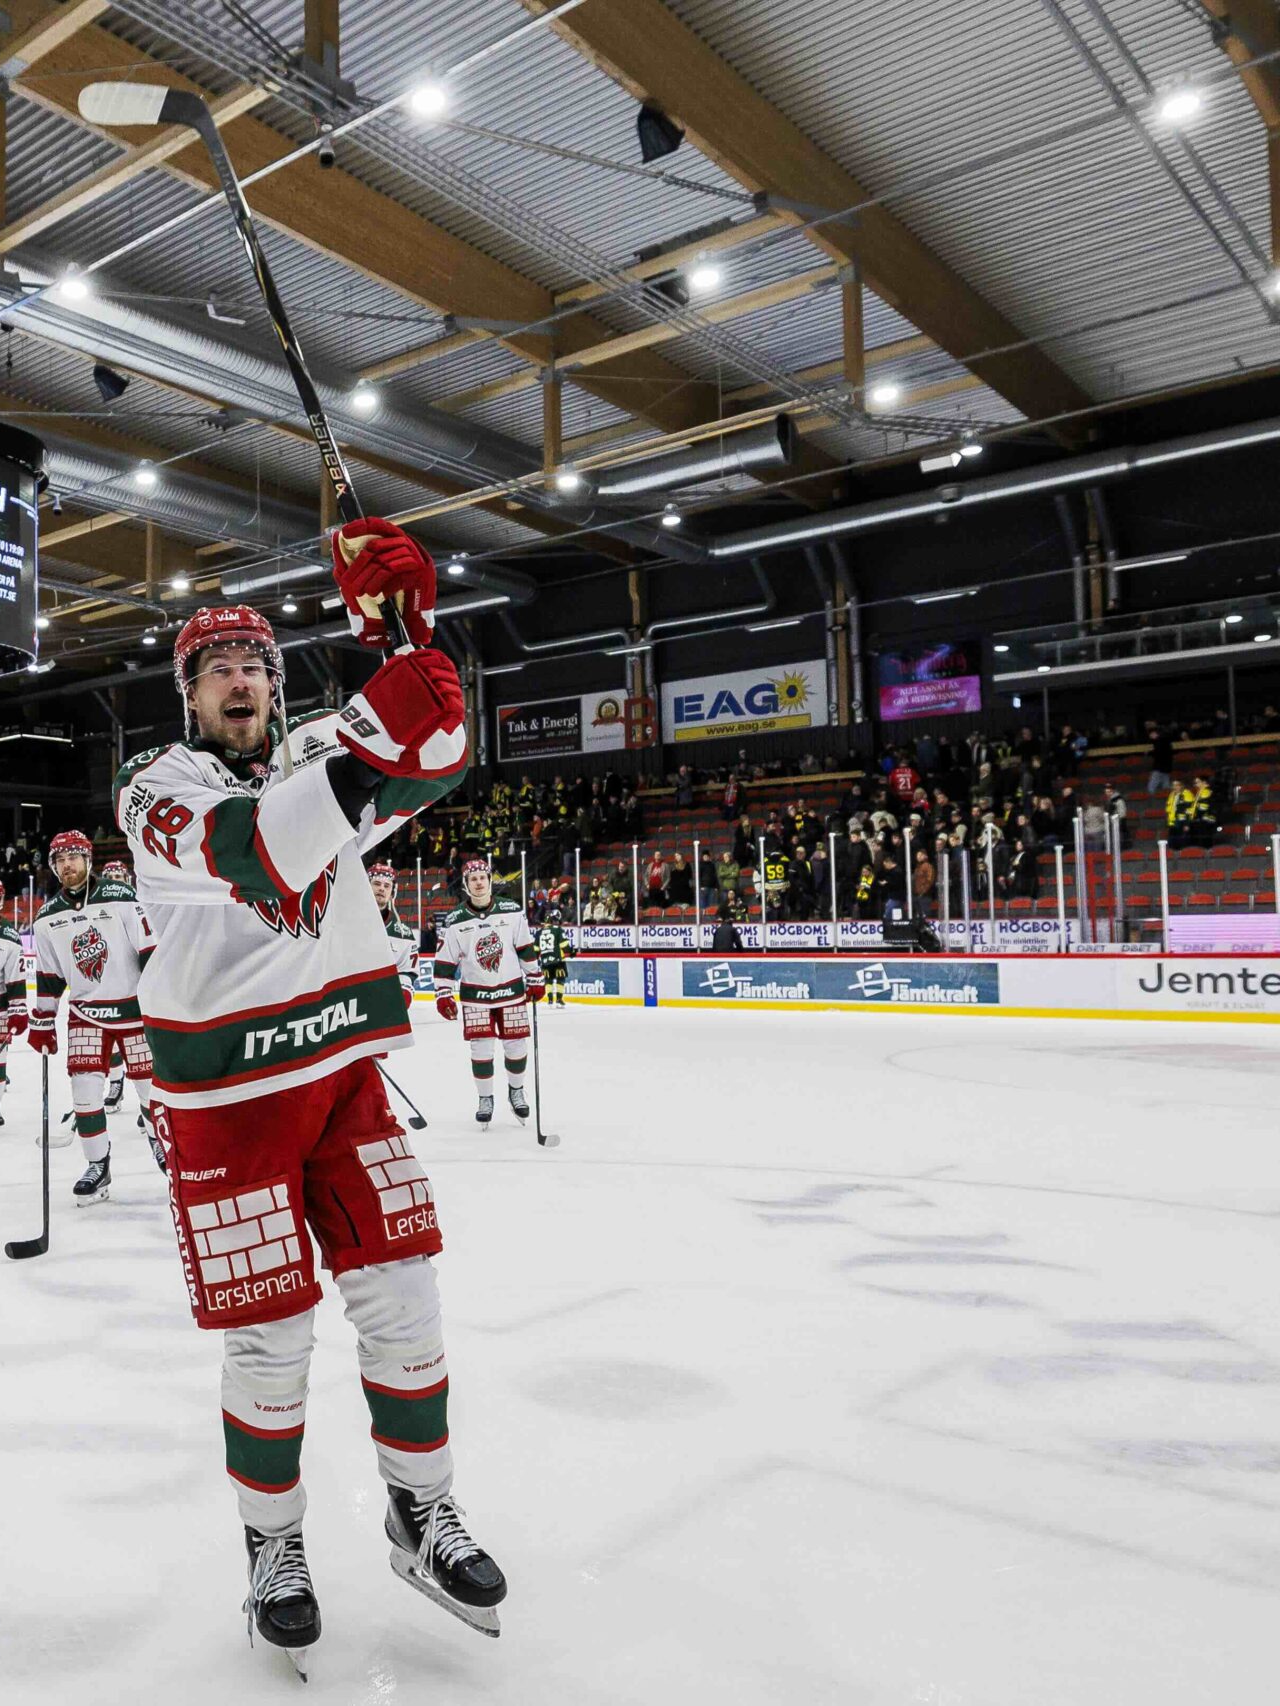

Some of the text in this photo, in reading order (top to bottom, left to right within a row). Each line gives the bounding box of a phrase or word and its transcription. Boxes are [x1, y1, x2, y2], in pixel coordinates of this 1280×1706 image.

[310, 411, 344, 481] BAUER
[2, 554, 22, 569] ARENA
[6, 575, 15, 588] PÅ
[674, 683, 779, 724] EAG
[507, 713, 578, 733] Tak & Energi
[705, 721, 776, 736] www.eag.se
[898, 777, 912, 790] 21
[142, 797, 194, 869] 26
[766, 864, 785, 880] 59
[583, 924, 633, 948] HÖGBOMS EL
[641, 924, 695, 948] HÖGBOMS EL
[770, 922, 831, 947] HÖGBOMS EL
[841, 922, 884, 936] HÖGBO
[476, 942, 503, 958] MODO
[539, 932, 555, 951] 63
[747, 936, 760, 947] EL
[781, 939, 809, 947] elektriker
[74, 940, 105, 963] MODO
[646, 959, 655, 997] CCM
[476, 987, 515, 999] IT-TOTAL
[735, 981, 809, 999] Jämtkraft
[890, 982, 979, 1003] Jämtkraft
[81, 1006, 122, 1020] TOTAL
[244, 998, 368, 1060] IT-TOTAL
[180, 1167, 227, 1182] BAUER
[205, 1269, 308, 1312] Lerstenen.
[412, 1352, 445, 1373] BAUER
[263, 1401, 303, 1413] BAUER
